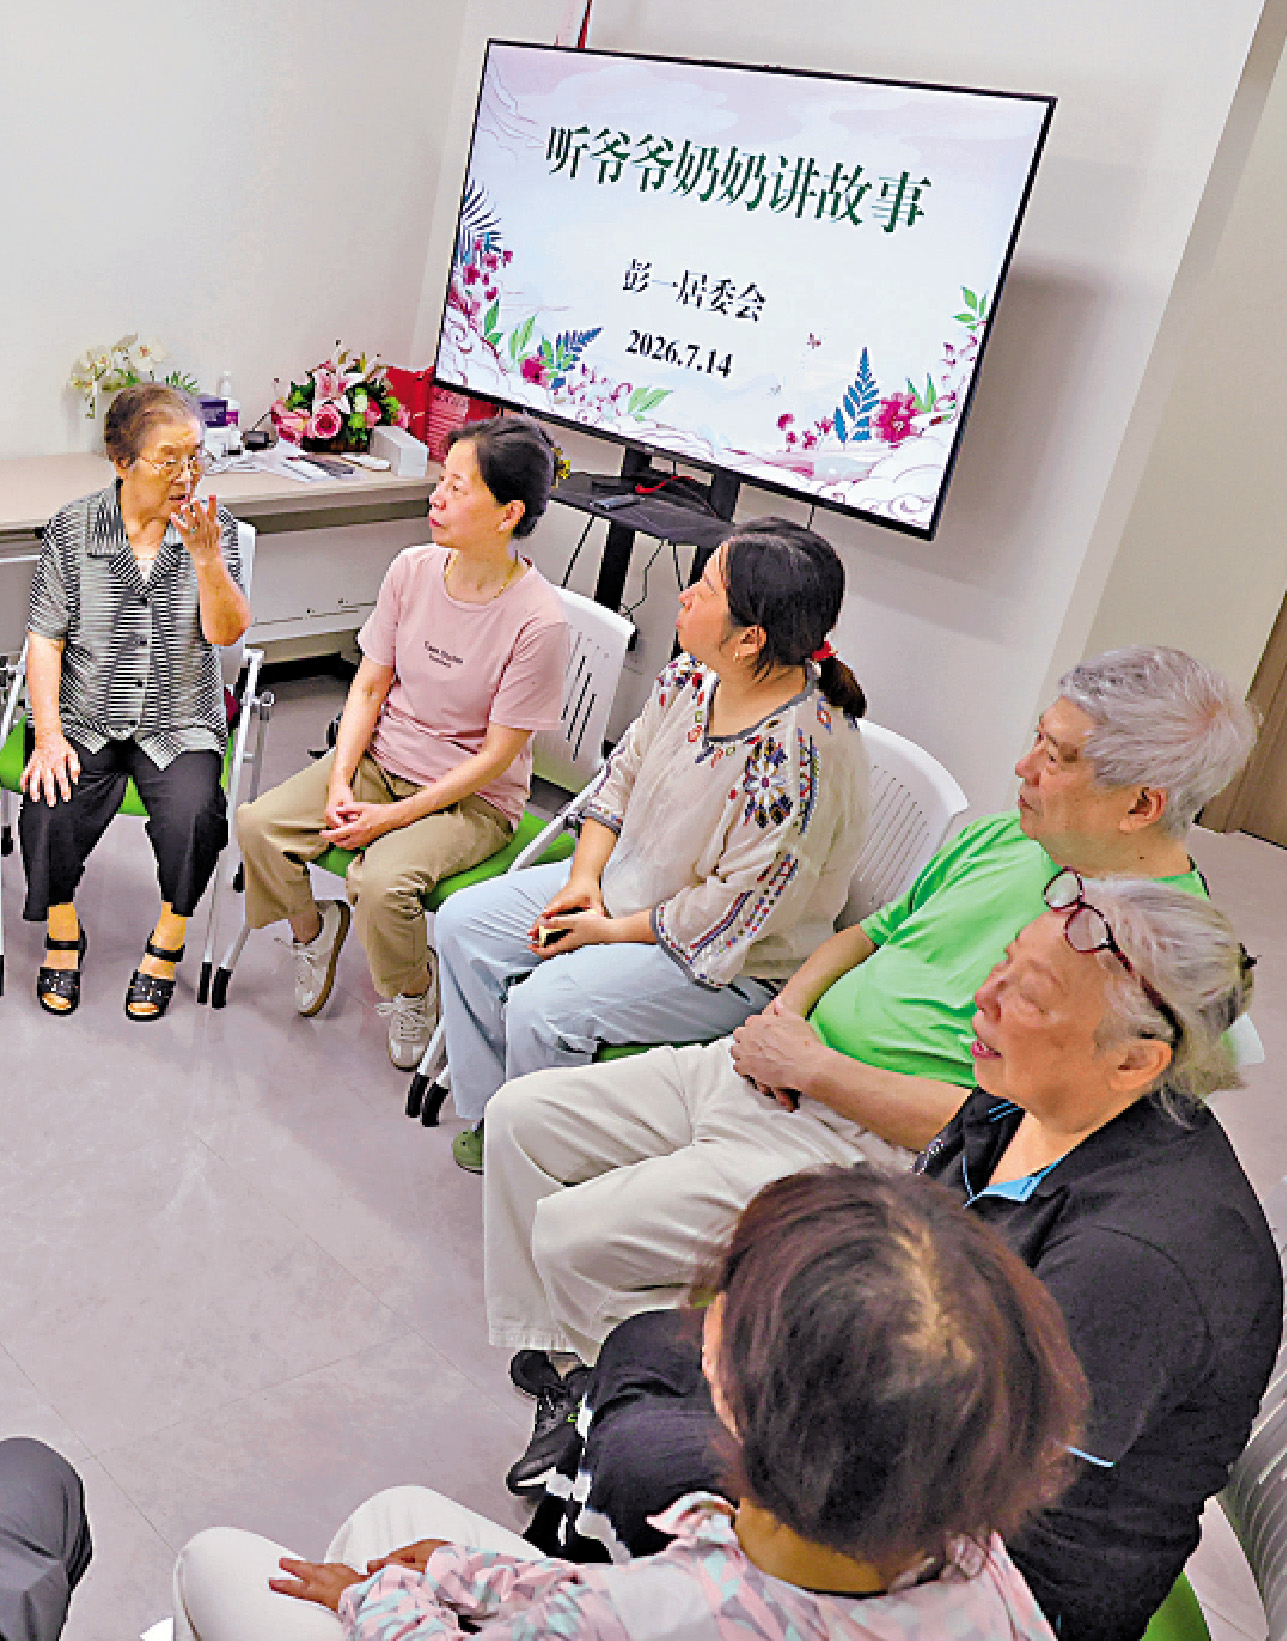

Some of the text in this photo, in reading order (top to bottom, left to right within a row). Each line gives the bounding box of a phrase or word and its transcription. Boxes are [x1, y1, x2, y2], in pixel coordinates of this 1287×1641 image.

[546, 125, 931, 233] 听爷爷奶奶讲故事
[623, 259, 766, 322] 彭一居委会
[625, 329, 733, 378] 2026.7.14
